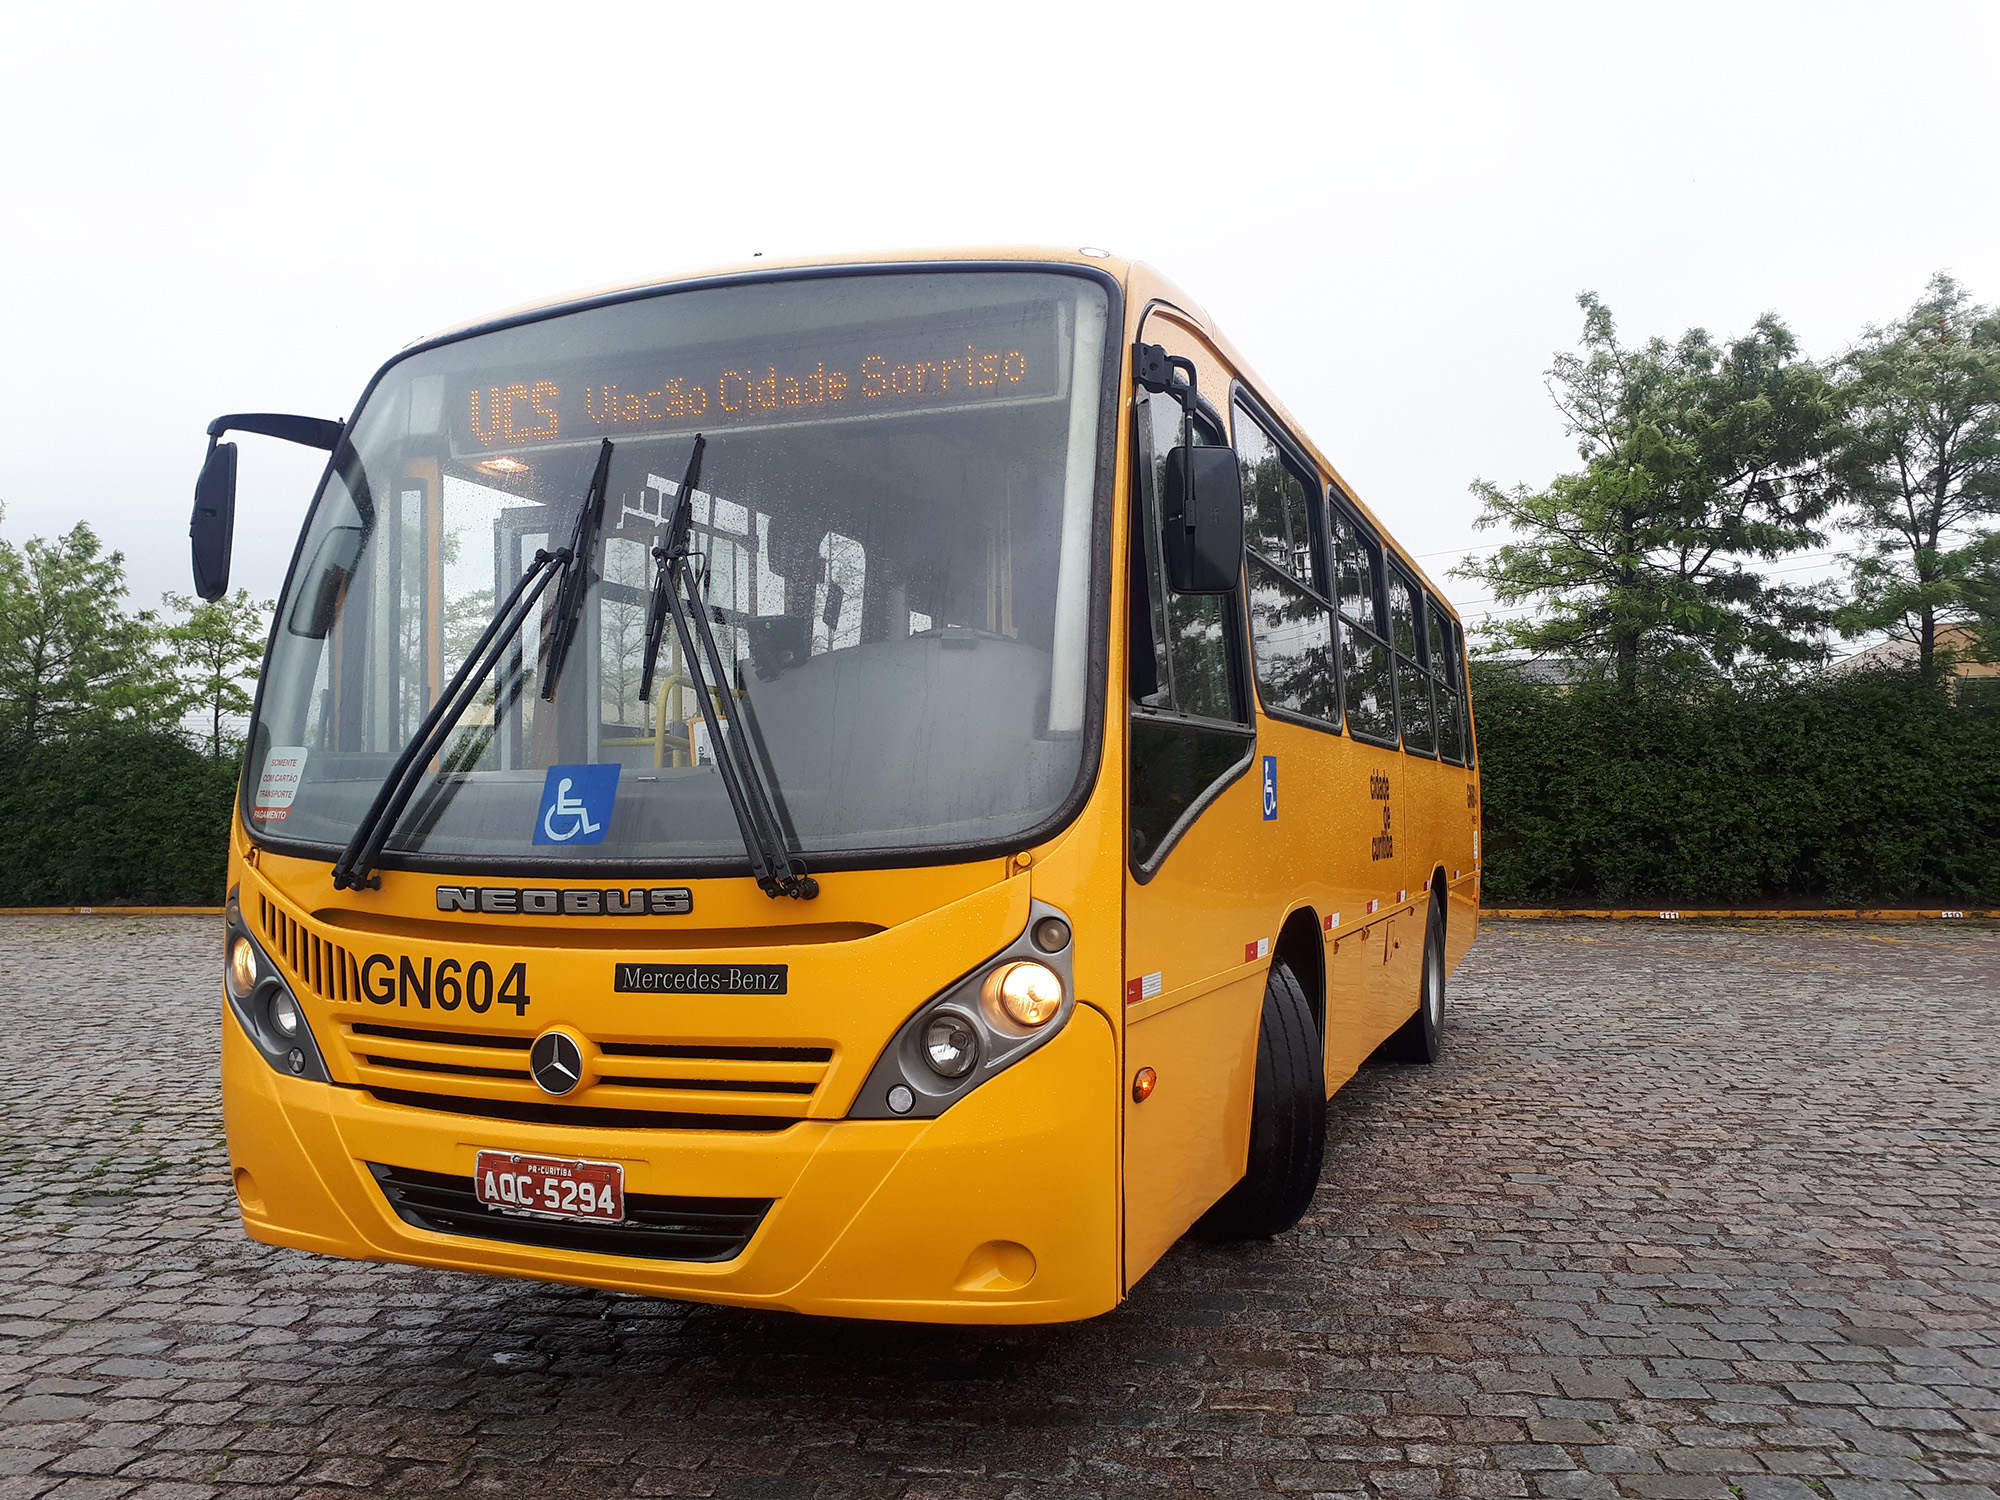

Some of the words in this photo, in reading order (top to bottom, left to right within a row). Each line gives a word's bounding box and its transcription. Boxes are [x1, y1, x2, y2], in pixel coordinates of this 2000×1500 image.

[719, 361, 847, 411] Cidade
[862, 345, 1025, 397] Sorriso
[263, 774, 275, 782] COM
[275, 773, 298, 783] CARTÃO
[1370, 768, 1390, 800] cidade
[259, 790, 292, 798] TRANSPORTE
[253, 810, 286, 819] PAGAMENTO
[1383, 800, 1390, 829] de
[1372, 830, 1393, 861] curitiba
[436, 886, 693, 914] NEOBUS
[361, 954, 531, 1016] GN604
[622, 967, 781, 991] Mercedes-Benz
